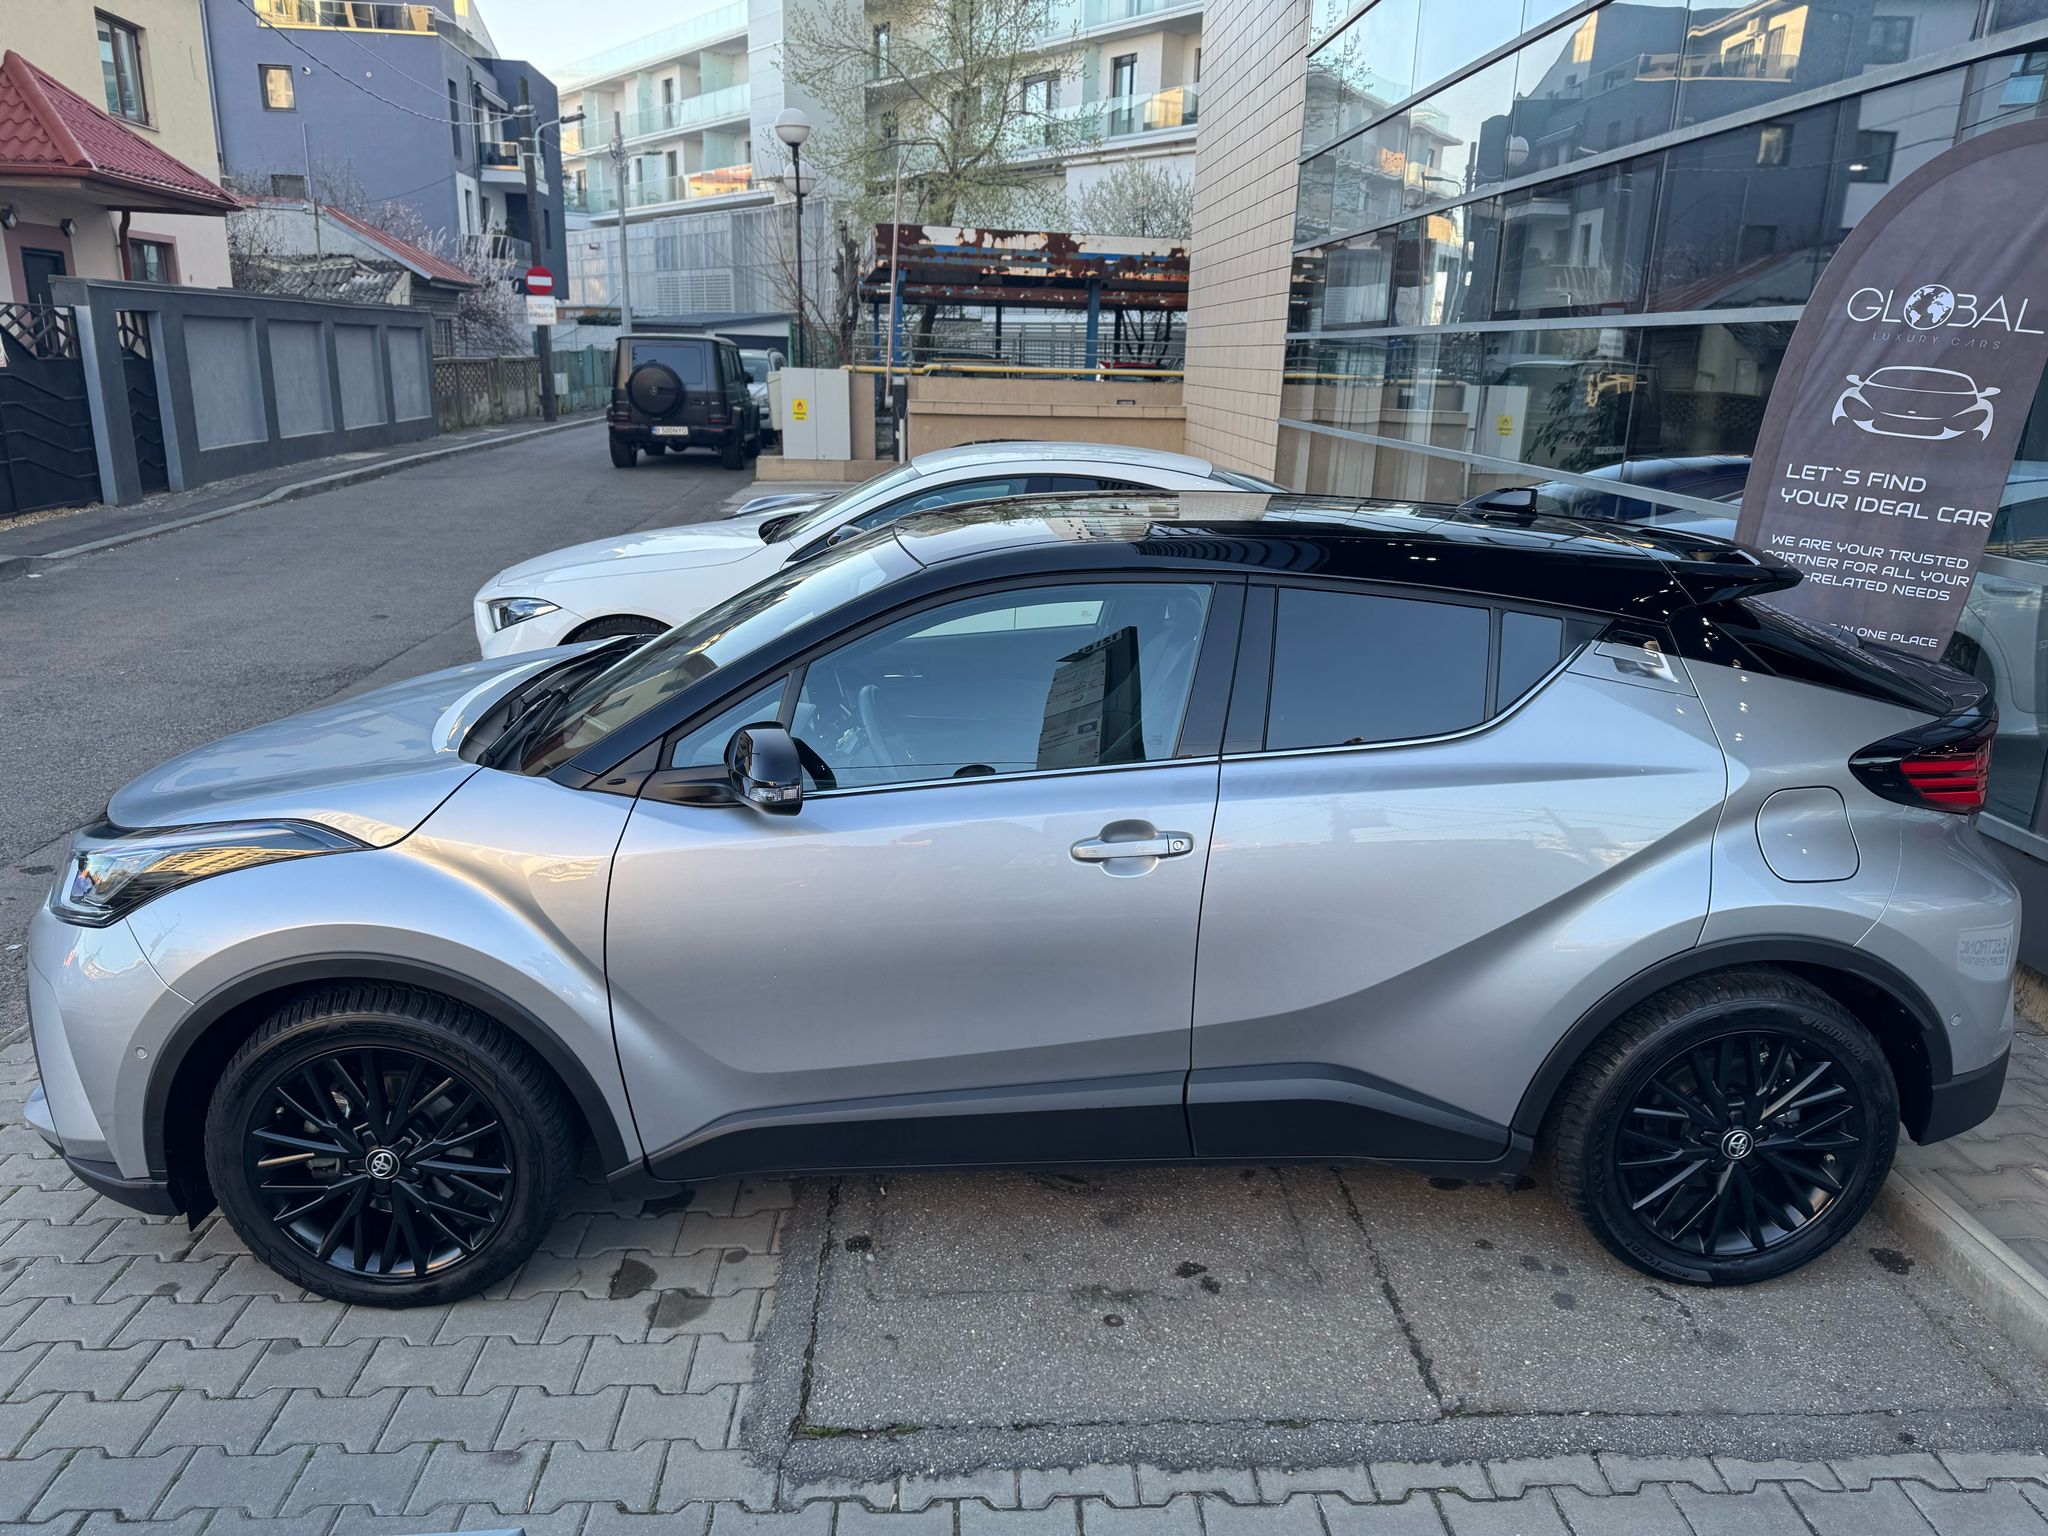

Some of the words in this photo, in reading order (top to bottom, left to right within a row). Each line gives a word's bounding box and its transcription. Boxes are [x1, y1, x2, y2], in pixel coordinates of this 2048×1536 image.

[1847, 284, 2044, 335] GLOBAL
[1872, 332, 1939, 344] LUXURY
[1951, 337, 2001, 350] CARS
[1866, 472, 1927, 493] FIND
[1781, 488, 1848, 510] YOUR
[1855, 496, 1929, 520] IDEAL
[1936, 507, 1993, 528] CAR
[1771, 533, 1796, 547] WE
[1799, 537, 1833, 551] ARE
[1836, 542, 1885, 559] YOUR
[1889, 549, 1969, 570] TRUSTED
[1842, 560, 1878, 575] FOR
[1881, 565, 1915, 580] ALL
[1920, 571, 1970, 587] YOUR
[1892, 584, 1950, 601] NEEDS
[1856, 627, 1888, 641] ONE
[1890, 633, 1939, 648] PLACE
